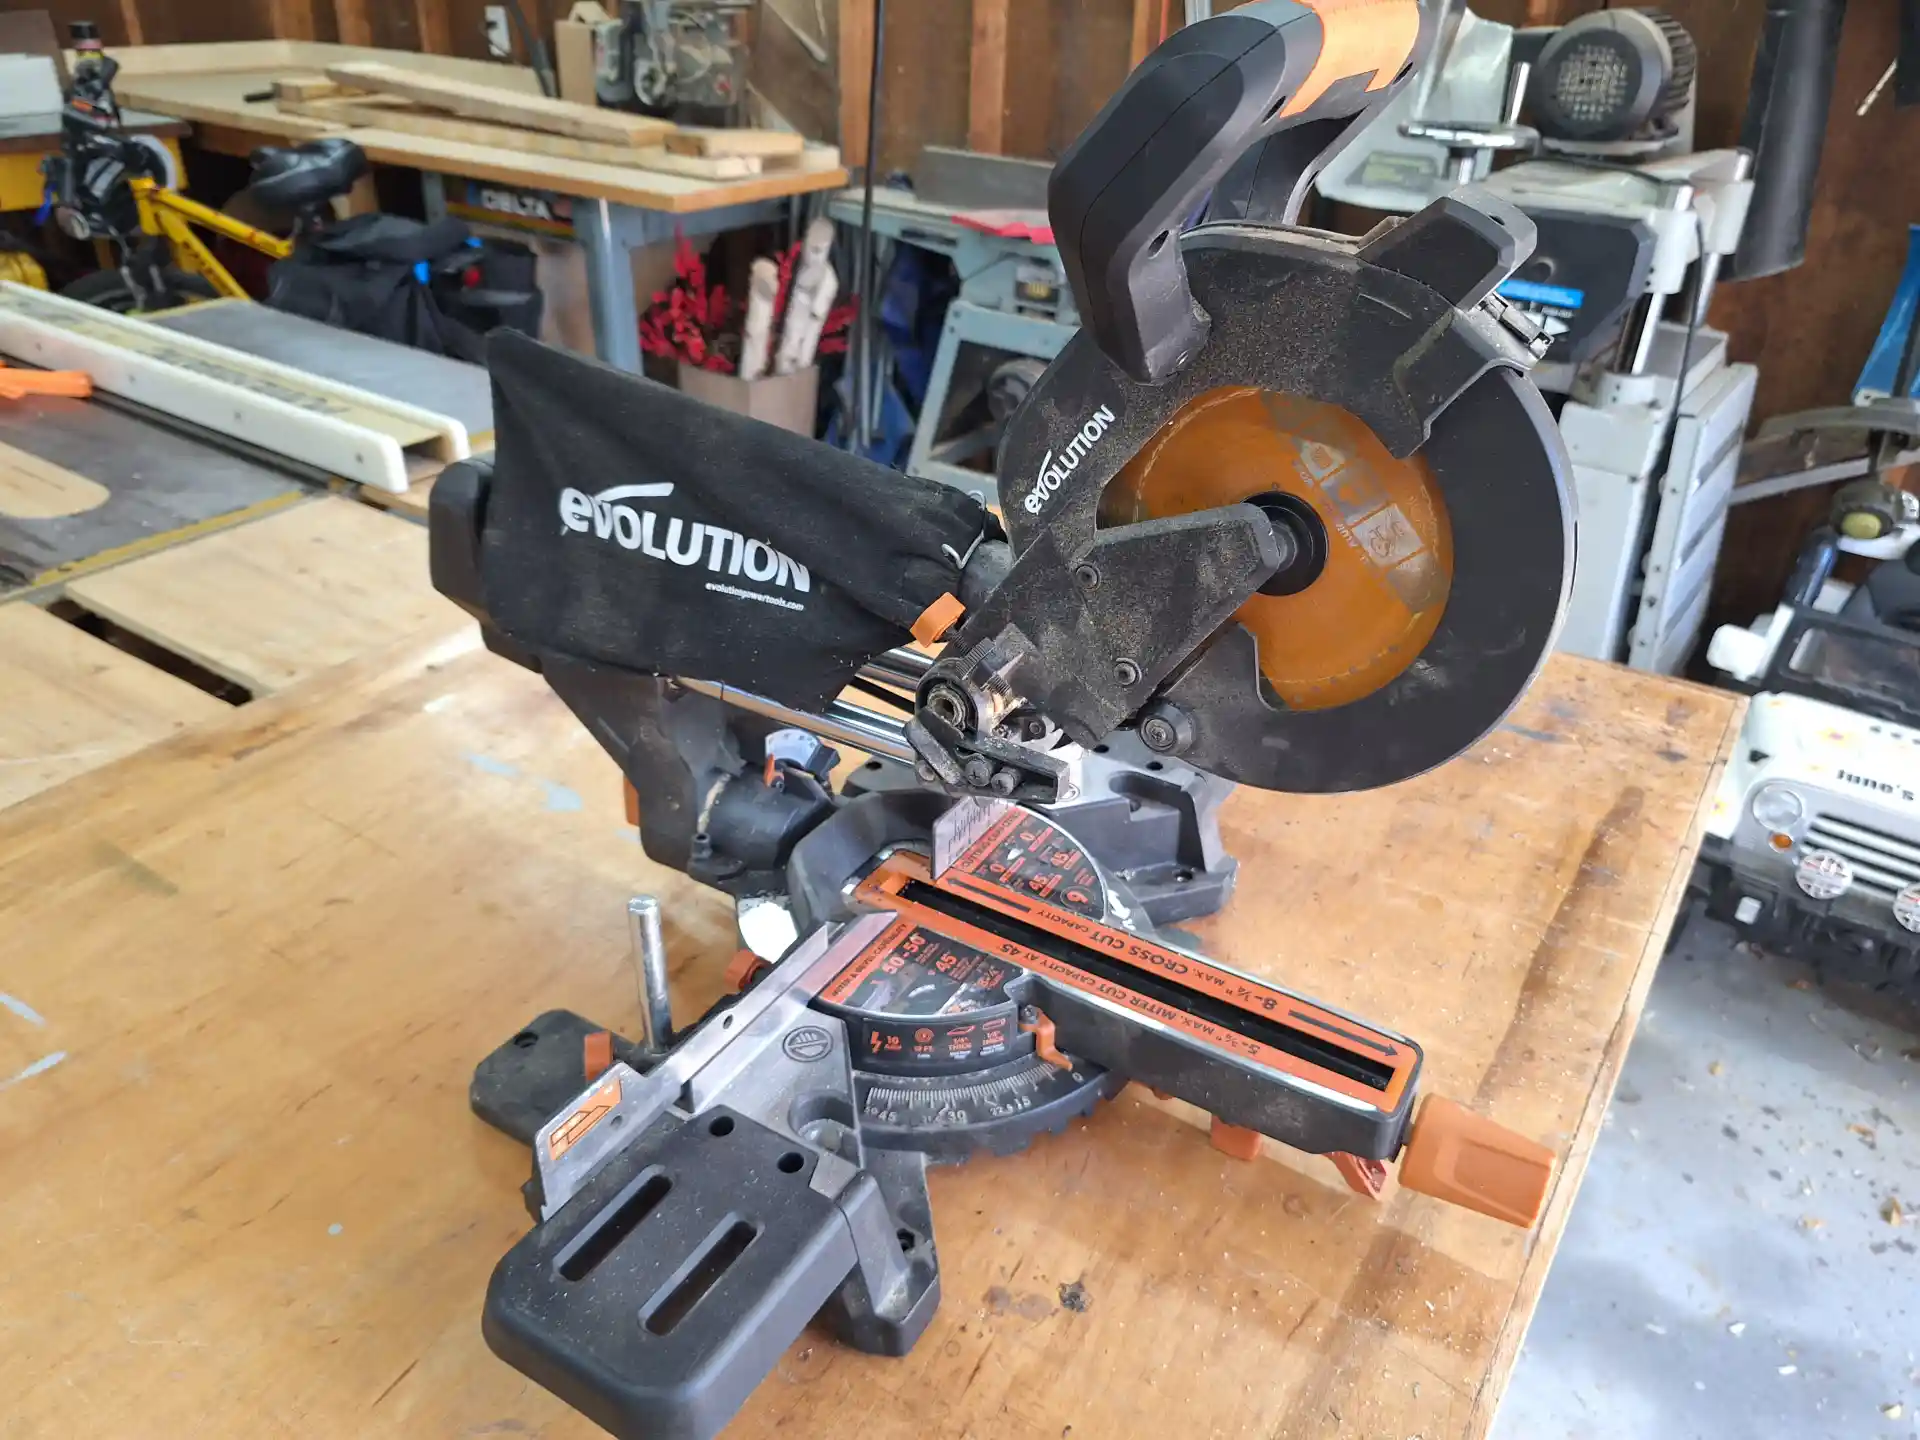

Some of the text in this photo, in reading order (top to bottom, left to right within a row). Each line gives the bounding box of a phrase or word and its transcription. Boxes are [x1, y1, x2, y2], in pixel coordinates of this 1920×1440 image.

[705, 582, 805, 611] evolutionpowertools.com
[1037, 910, 1089, 932] CAPACITY
[1089, 930, 1125, 950] CUT
[1023, 952, 1039, 962] AT
[1127, 944, 1188, 975] CROSS
[1040, 959, 1096, 988] CAPACITY
[1098, 983, 1128, 1001] CUT
[1129, 996, 1177, 1021] MITER
[1014, 1095, 1032, 1110] 15
